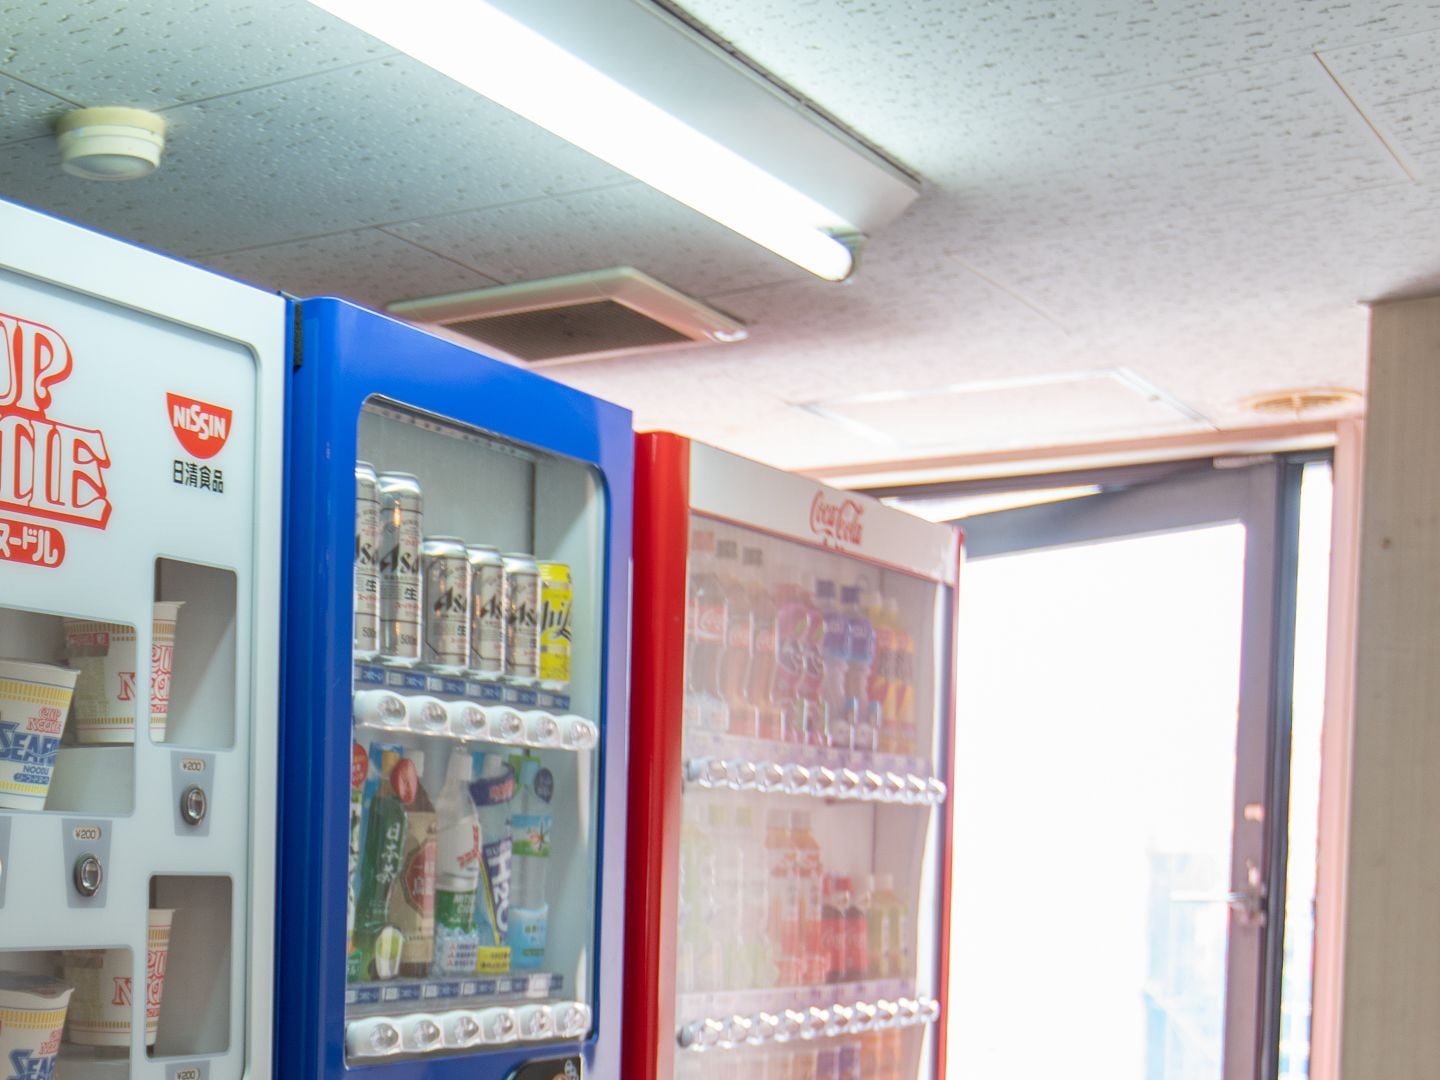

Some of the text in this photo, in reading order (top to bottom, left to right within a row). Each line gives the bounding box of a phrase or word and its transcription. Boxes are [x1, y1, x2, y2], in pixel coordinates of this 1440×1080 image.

[173, 404, 226, 441] NISSIN
[173, 460, 225, 494] 日清食品
[76, 828, 97, 840] ¥200
[176, 1071, 196, 1080] ¥200
